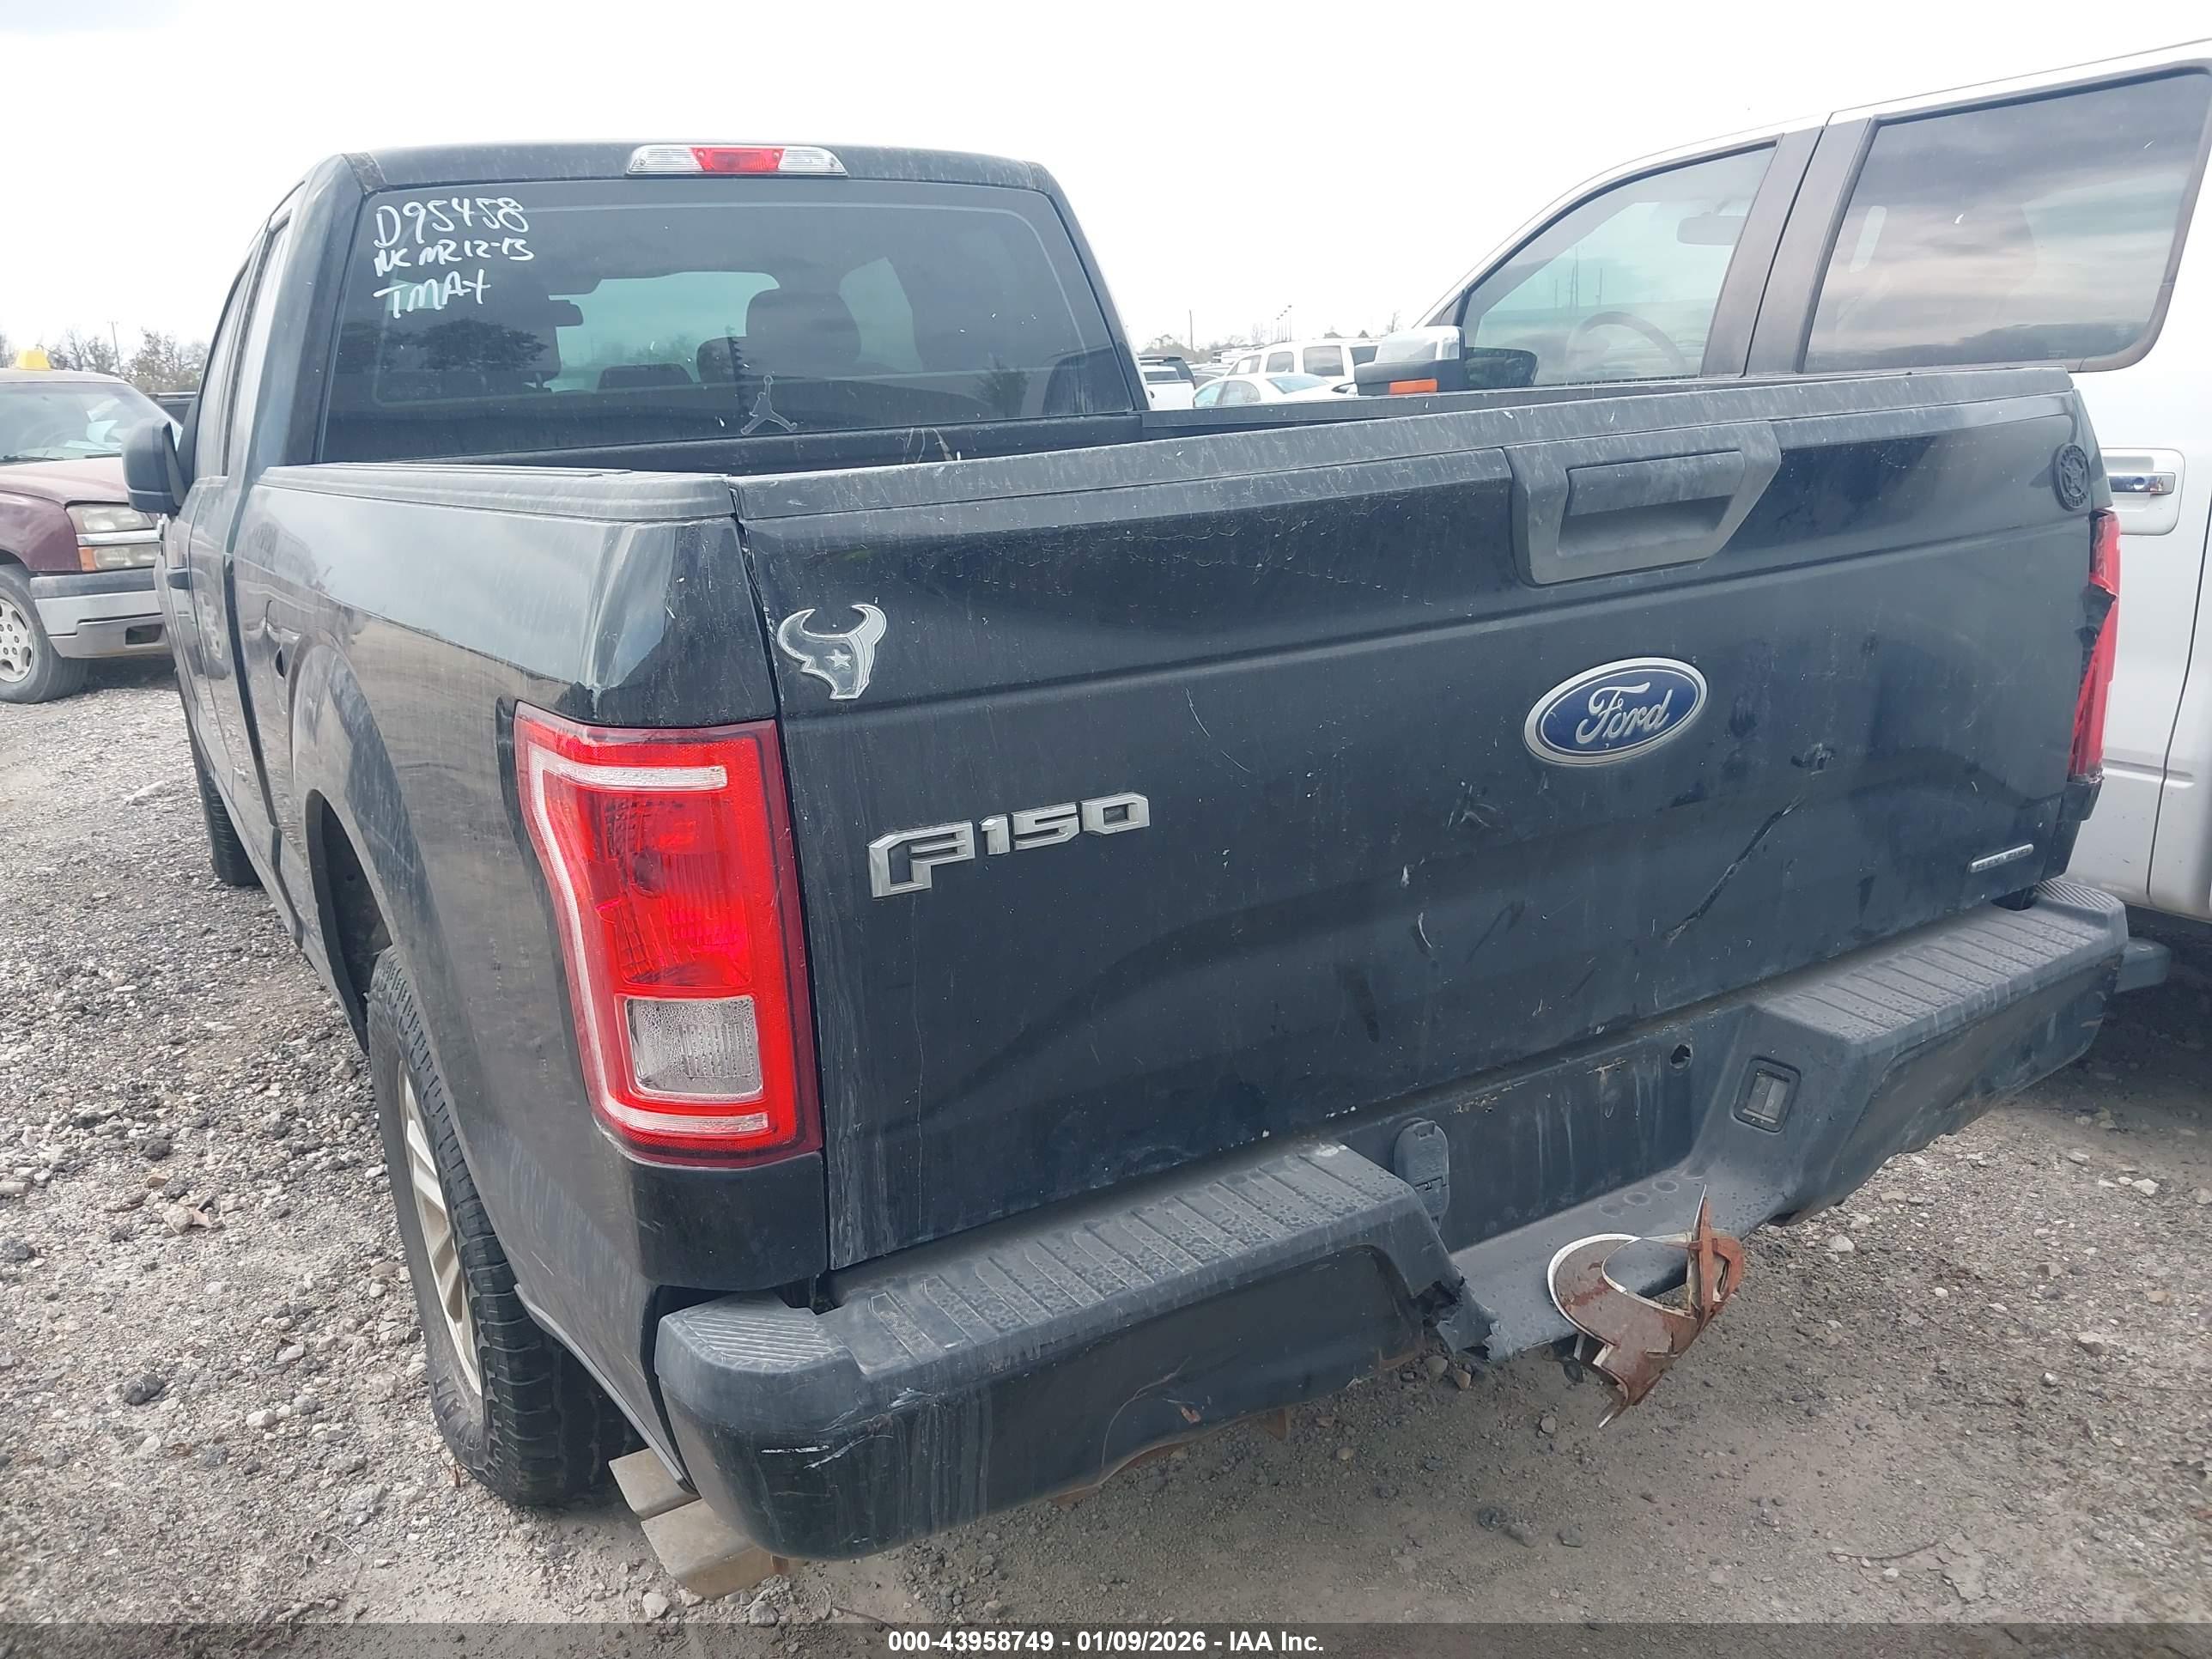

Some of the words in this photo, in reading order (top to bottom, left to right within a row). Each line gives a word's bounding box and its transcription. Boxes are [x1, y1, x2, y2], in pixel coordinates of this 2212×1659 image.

[373, 197, 529, 249] D95458
[1575, 681, 1674, 744] Ford
[867, 792, 1151, 899] F150
